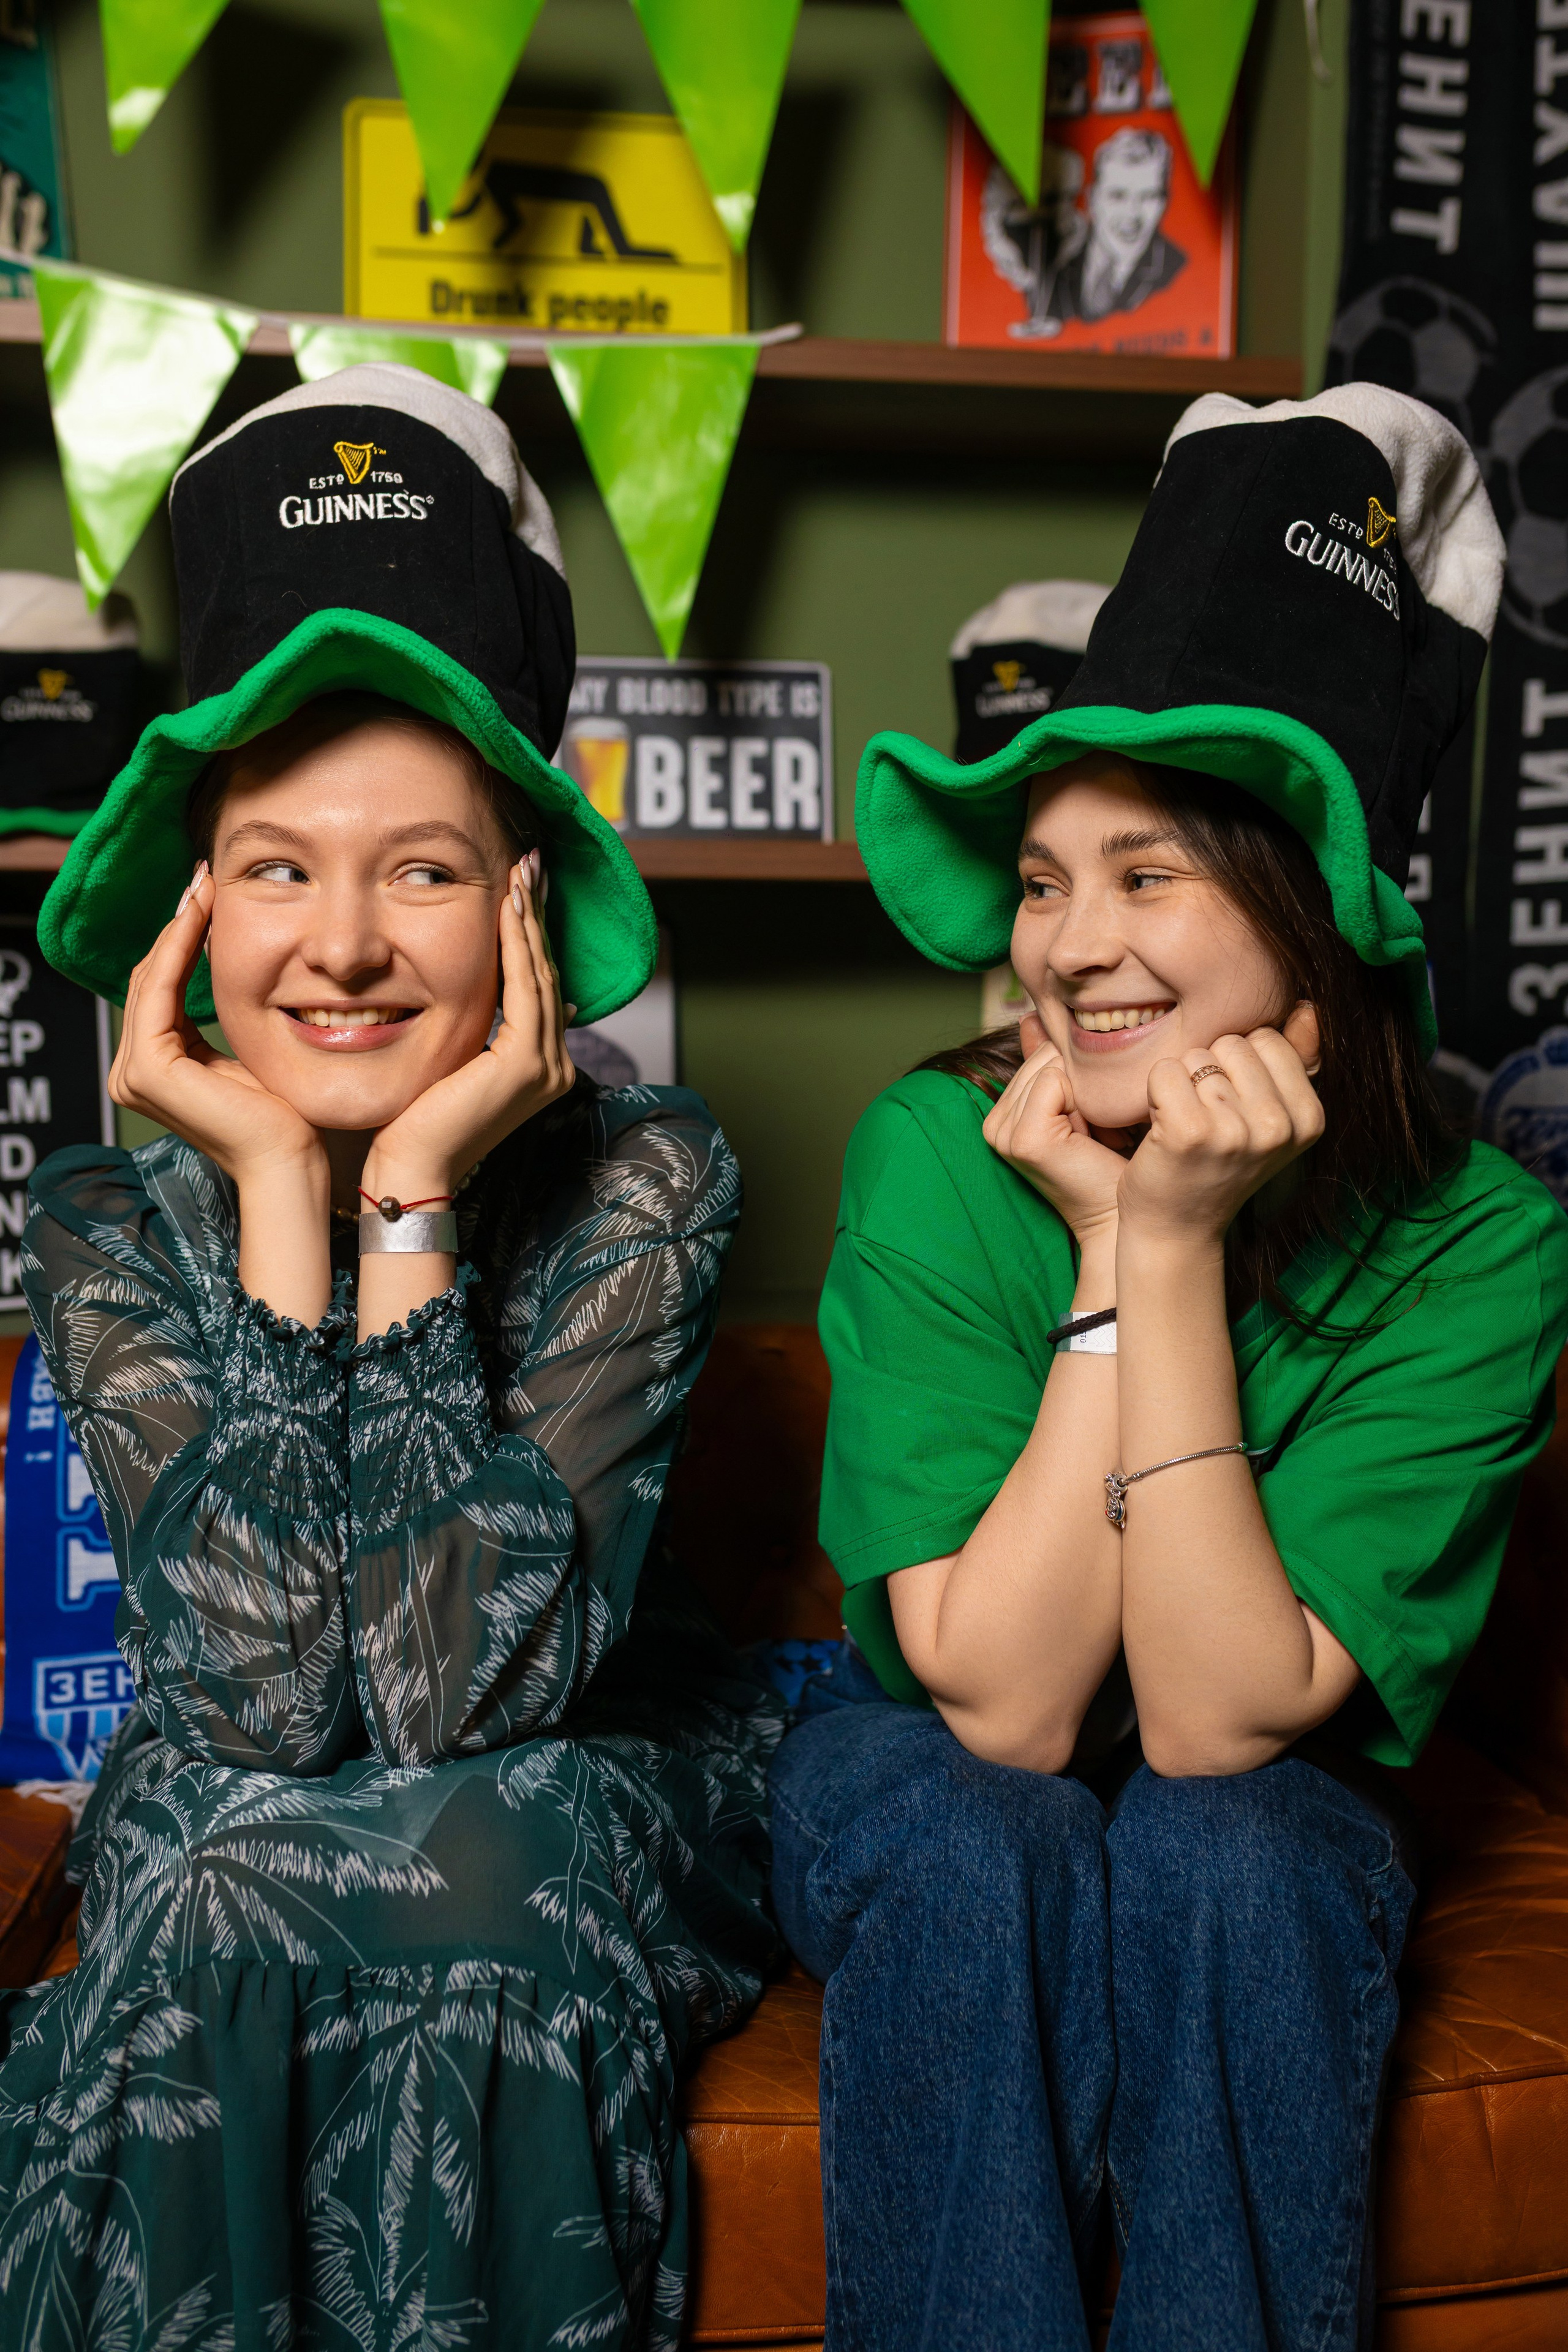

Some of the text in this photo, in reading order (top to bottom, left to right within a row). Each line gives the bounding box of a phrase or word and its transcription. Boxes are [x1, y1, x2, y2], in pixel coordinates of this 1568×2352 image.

[431, 279, 670, 333] Drunk people
[279, 492, 428, 529] GUINNESS
[617, 677, 707, 716] BLOOD
[716, 680, 783, 718] TYPE
[790, 682, 821, 718] IS
[634, 734, 821, 830] BEER
